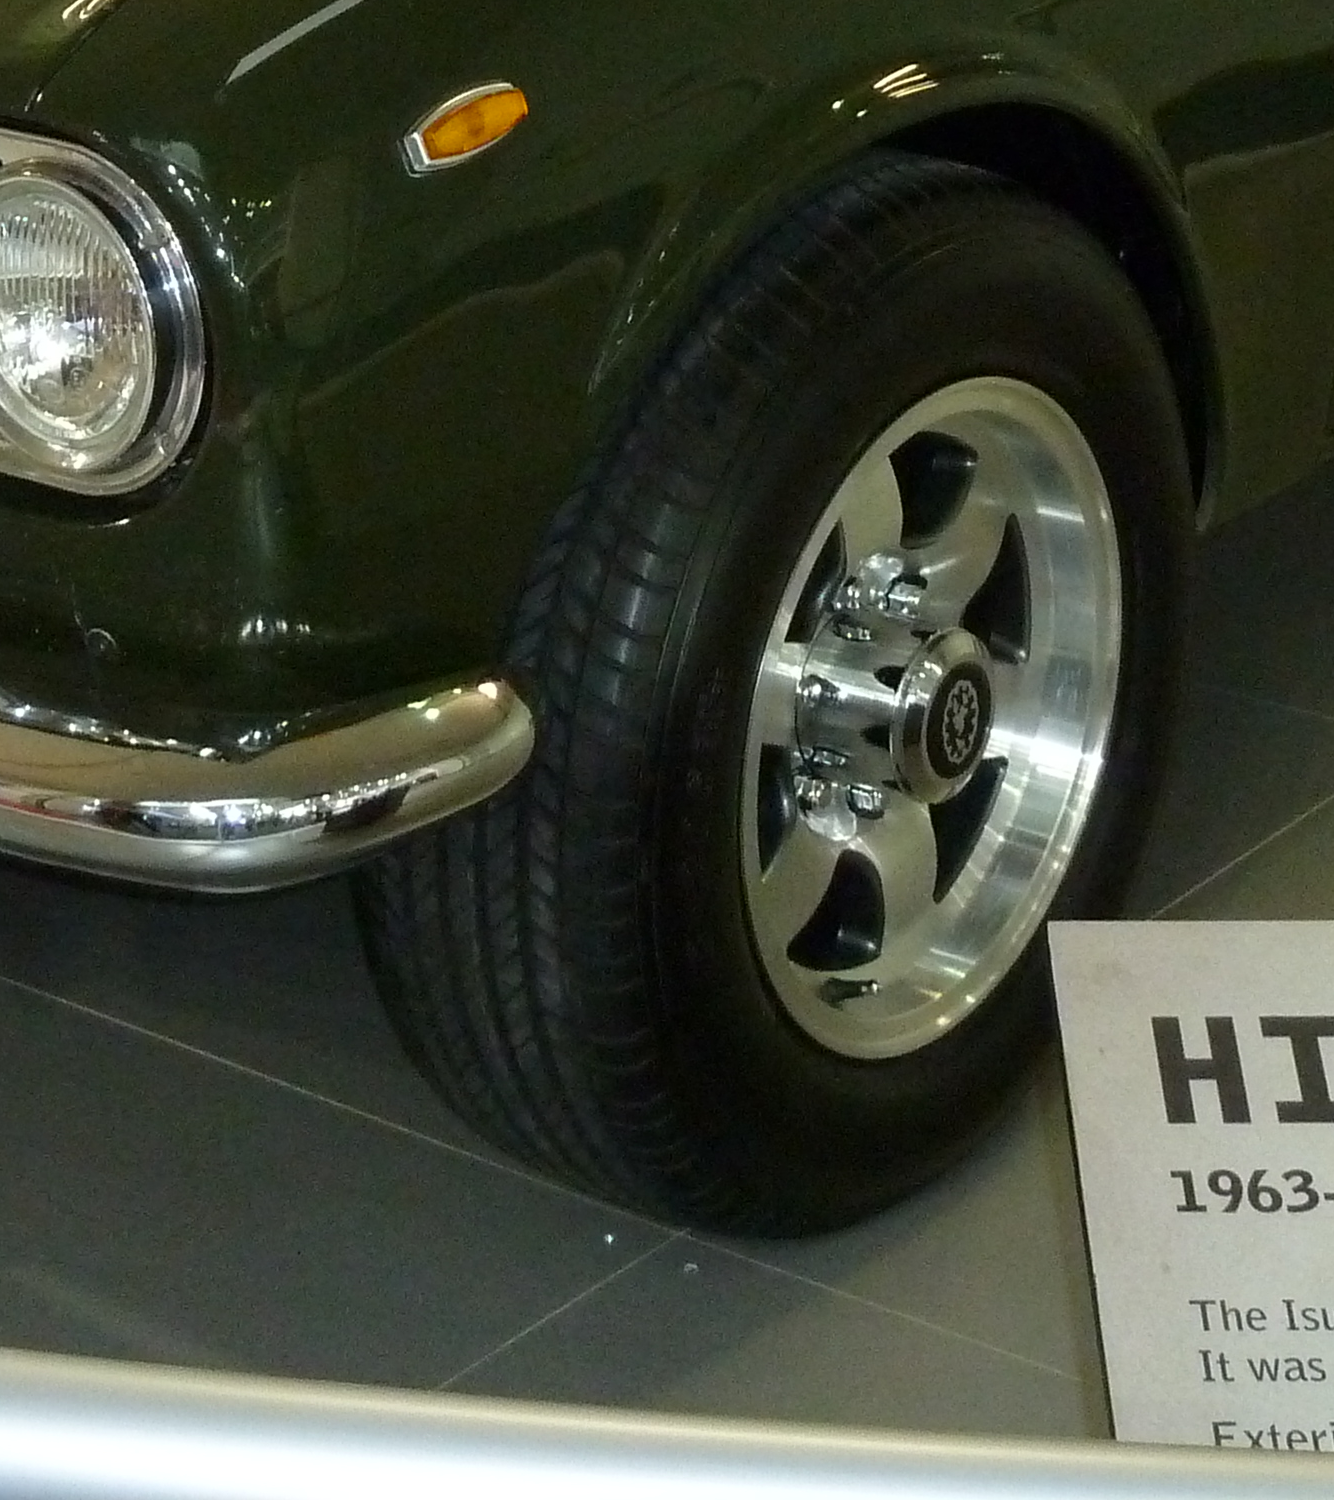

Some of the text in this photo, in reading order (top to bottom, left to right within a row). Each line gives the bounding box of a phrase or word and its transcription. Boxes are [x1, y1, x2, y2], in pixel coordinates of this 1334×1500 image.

[1188, 1299, 1268, 1332] The
[1198, 1349, 1235, 1383] It
[1246, 1357, 1327, 1383] was
